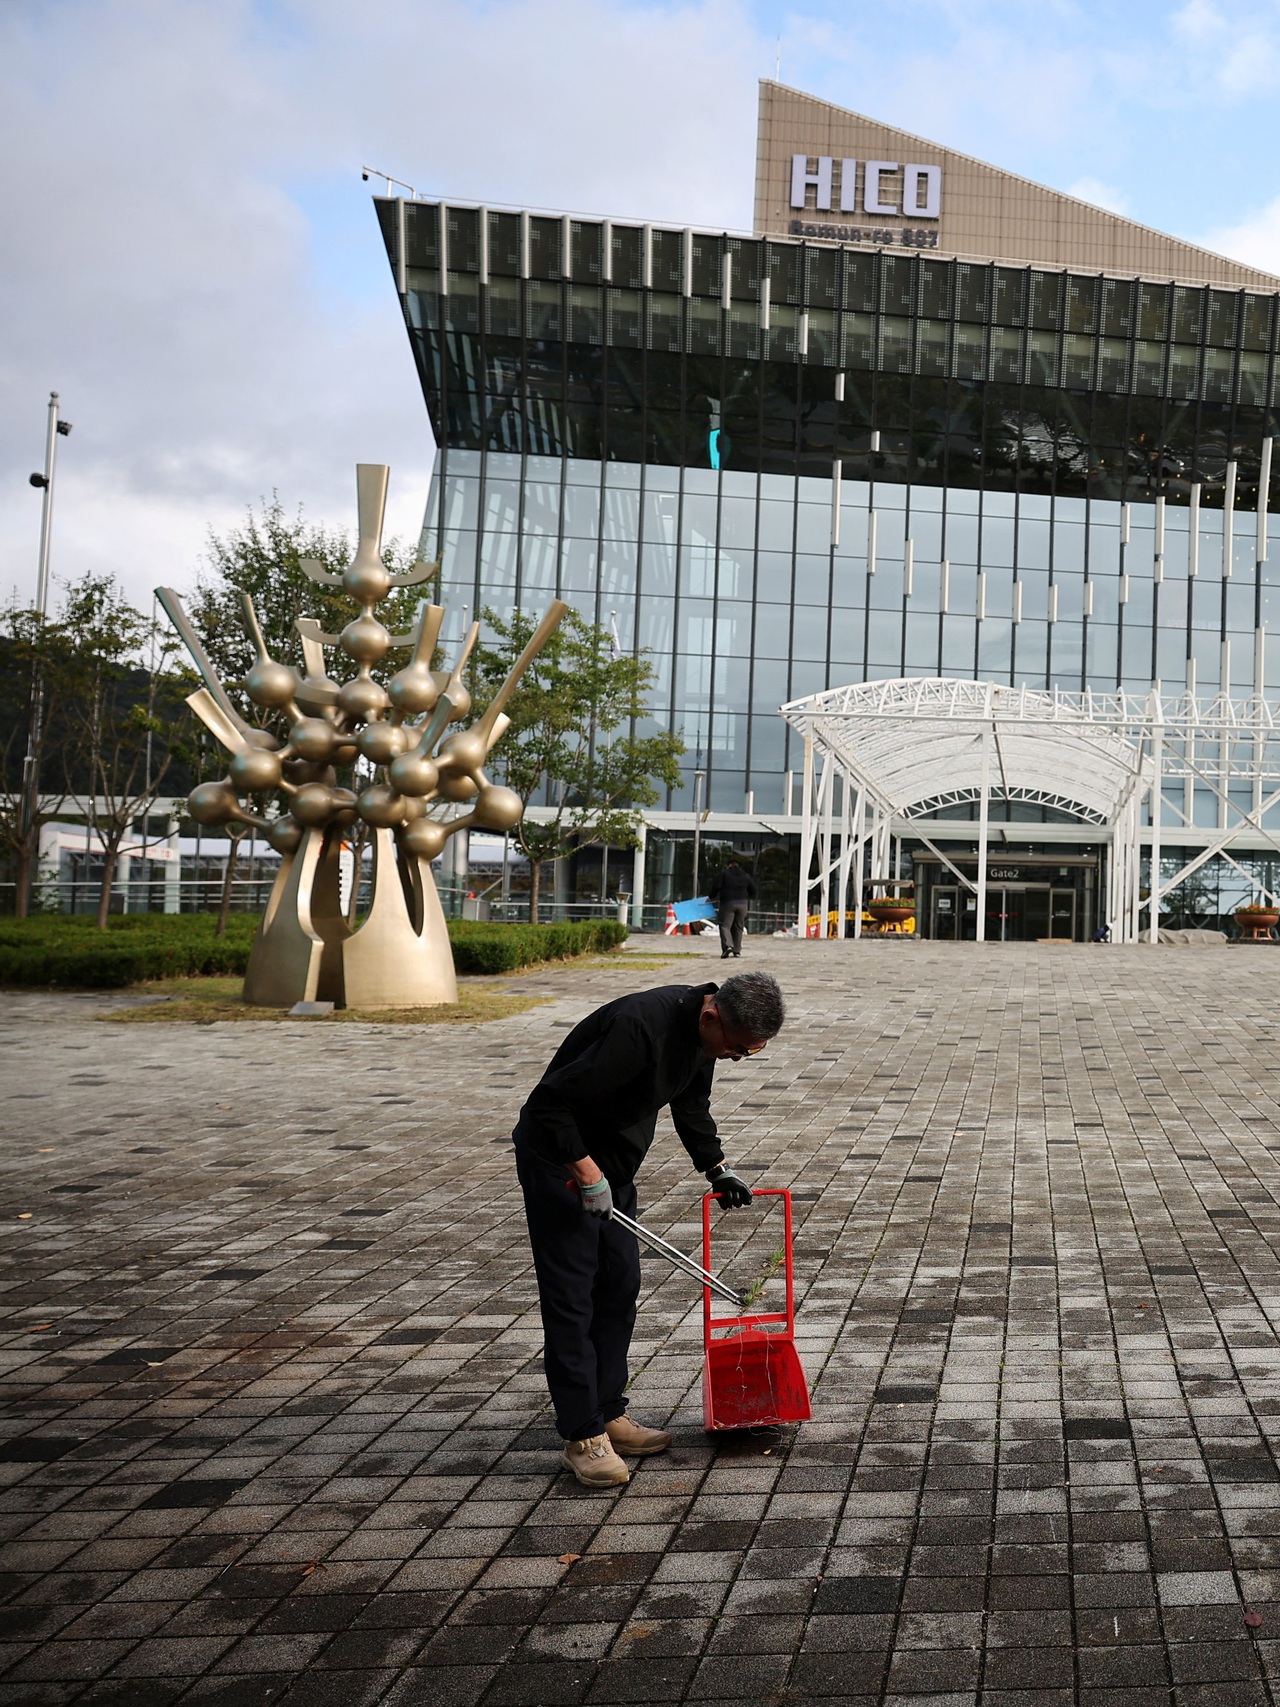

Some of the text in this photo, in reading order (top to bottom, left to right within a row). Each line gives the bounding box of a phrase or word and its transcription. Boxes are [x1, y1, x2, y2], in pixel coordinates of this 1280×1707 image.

[791, 154, 942, 218] HICO
[791, 220, 939, 247] Bomun-ro 507
[990, 868, 1020, 879] Gate2
